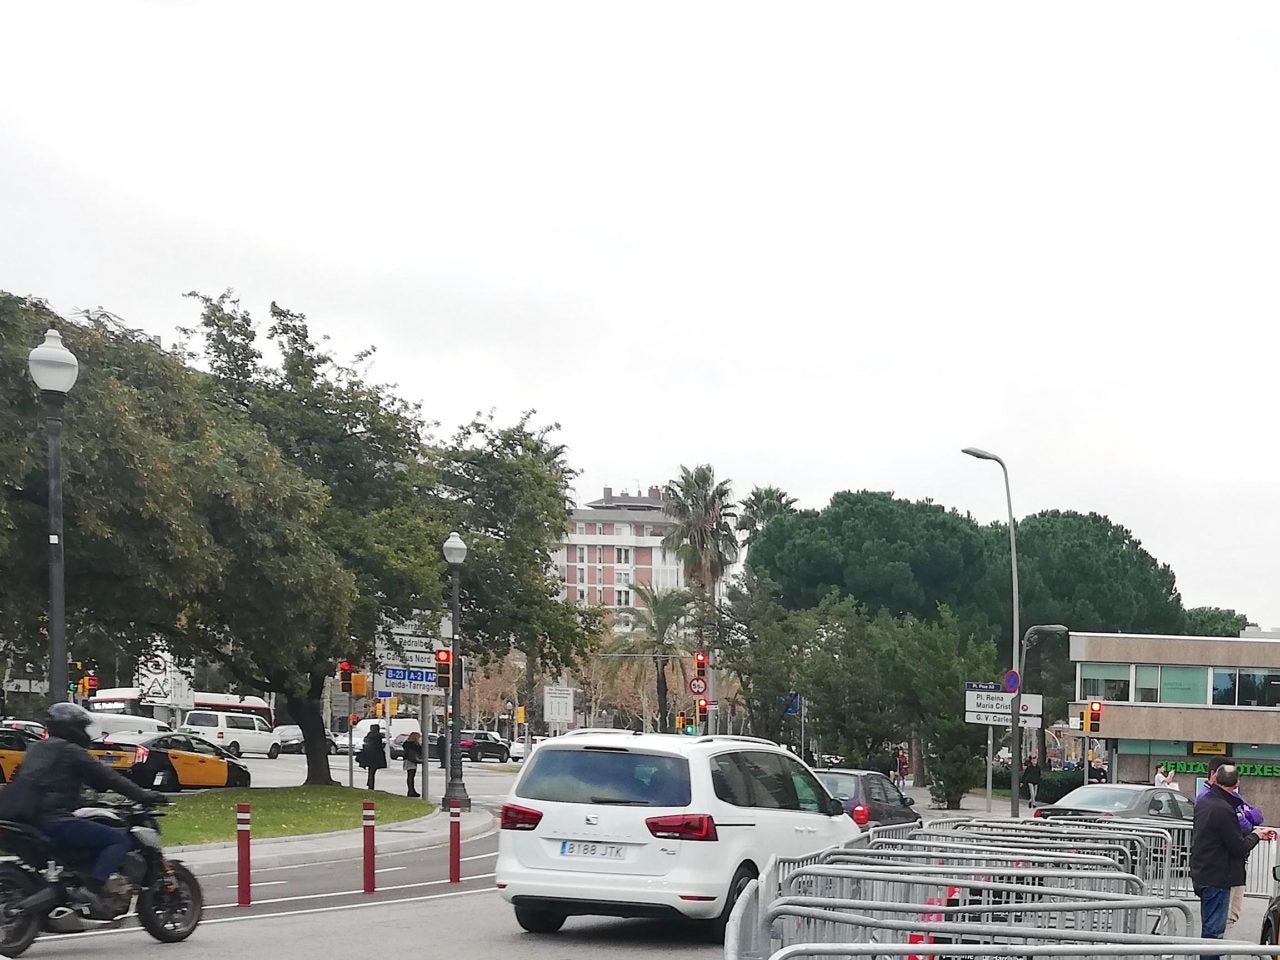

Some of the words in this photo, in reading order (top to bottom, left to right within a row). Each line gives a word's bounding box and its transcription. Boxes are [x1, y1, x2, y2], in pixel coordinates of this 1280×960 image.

[995, 702, 1011, 710] Crist
[567, 843, 596, 856] 8188
[600, 846, 623, 857] JTK
